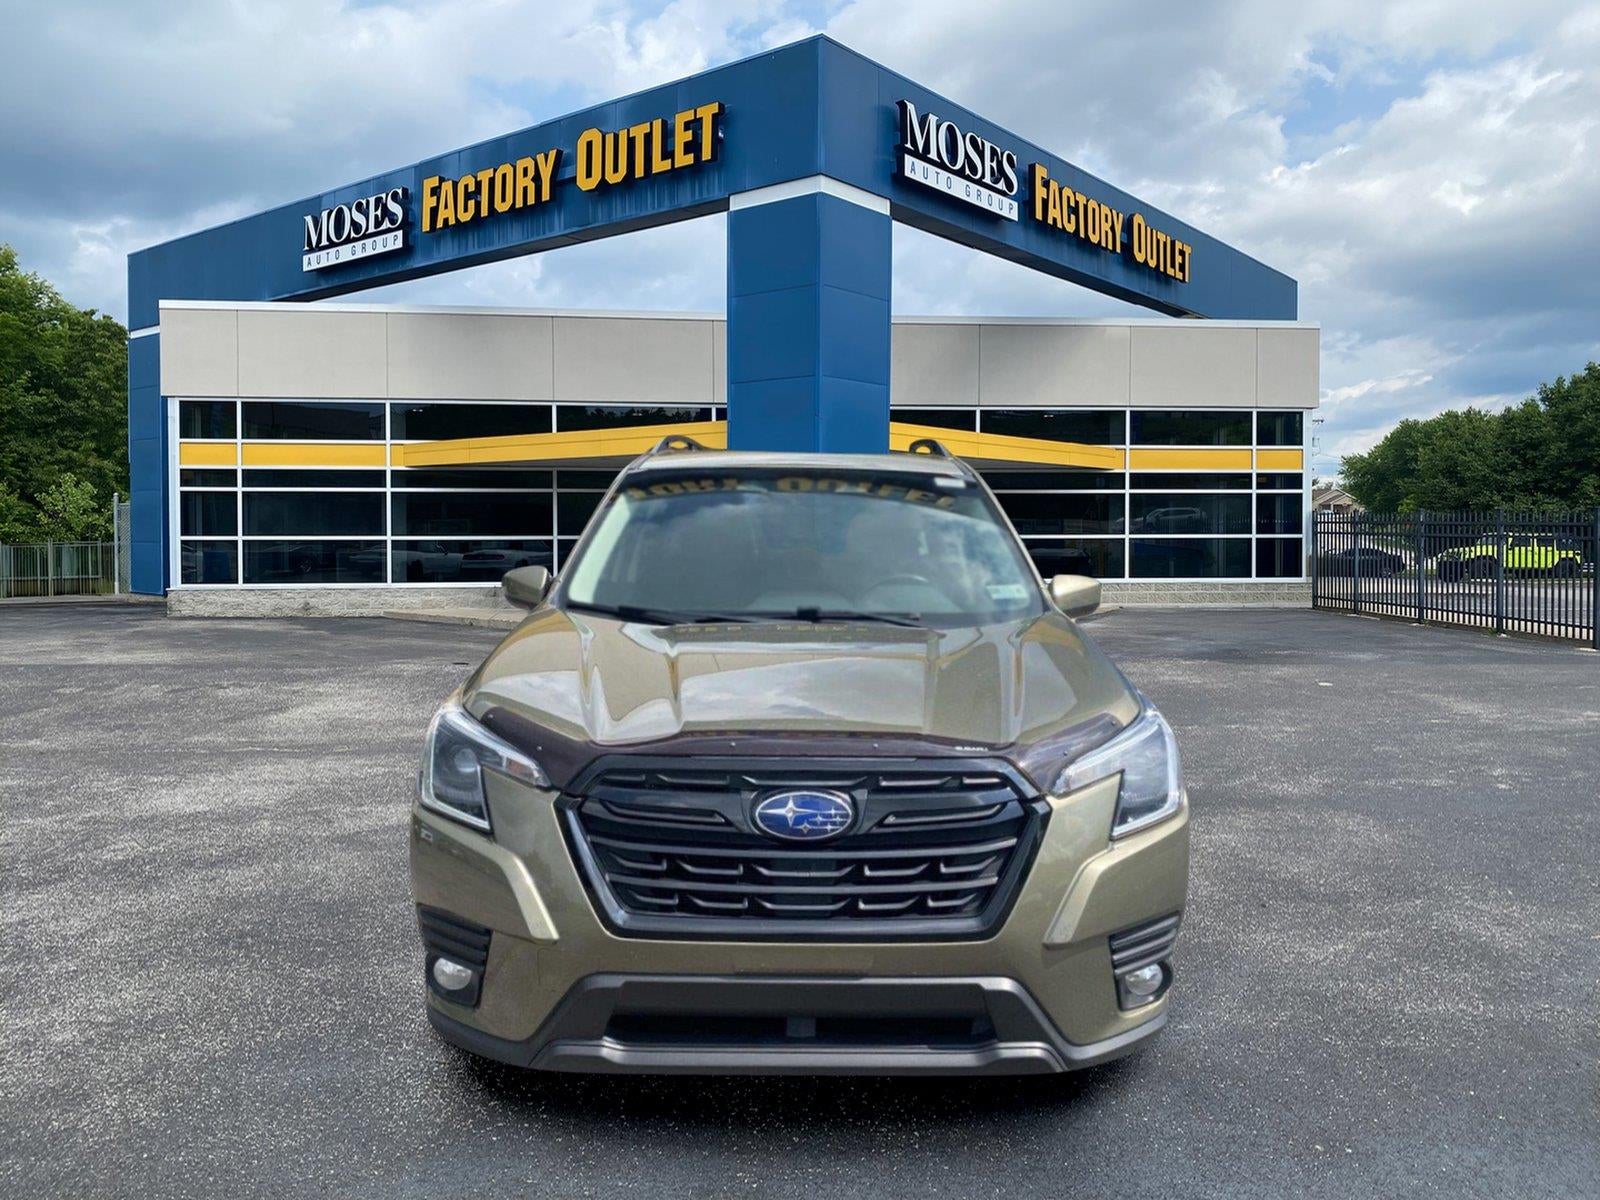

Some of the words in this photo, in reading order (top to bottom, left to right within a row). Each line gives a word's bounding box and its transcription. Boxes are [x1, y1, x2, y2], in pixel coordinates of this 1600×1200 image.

[421, 148, 558, 233] FACTORY
[576, 101, 719, 191] OUTLET
[904, 99, 1018, 196] MOSES
[302, 187, 403, 251] MOSES
[909, 161, 953, 190] AUTO
[964, 184, 1014, 215] GROUP
[1034, 162, 1124, 254] FACTORY
[1132, 212, 1192, 283] OUTLET
[306, 248, 341, 267] AUTO
[350, 234, 399, 256] GROUP
